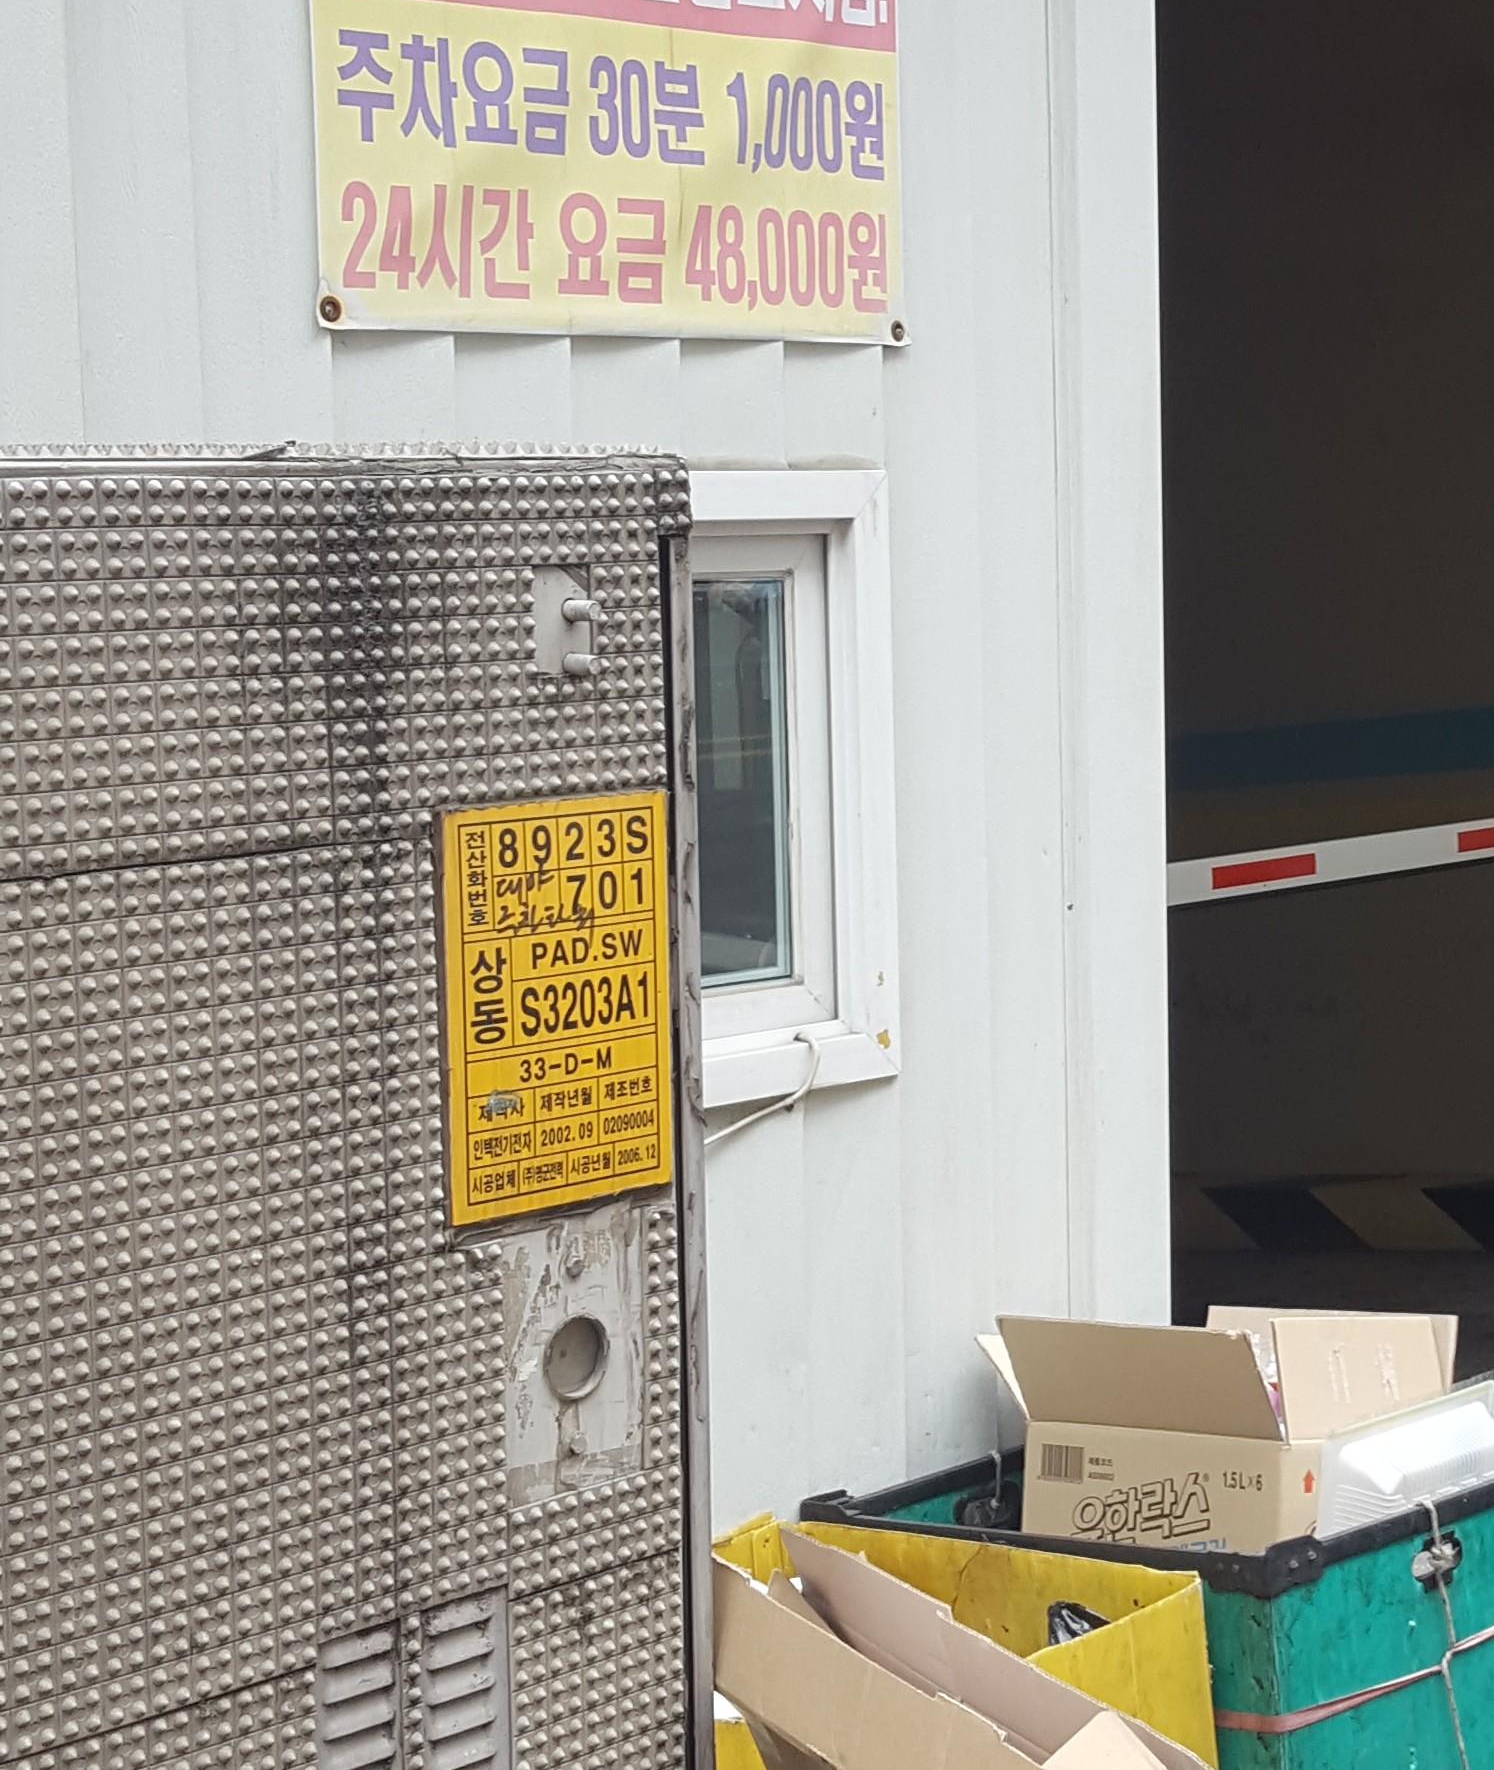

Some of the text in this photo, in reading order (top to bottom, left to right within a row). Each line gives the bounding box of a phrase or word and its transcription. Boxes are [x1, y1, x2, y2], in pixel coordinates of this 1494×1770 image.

[336, 29, 885, 181] 주차요금 30분 1,000원
[341, 180, 888, 313] 24시간 요금 48,000원
[531, 929, 643, 969] PAD.SW
[521, 971, 649, 1037] S3203A1
[520, 1046, 612, 1083] 33-D-M
[540, 1086, 593, 1112] 제작년월
[604, 1076, 653, 1100] 제조번호
[603, 1109, 655, 1135] 02090004
[472, 1169, 517, 1194] 시공업체
